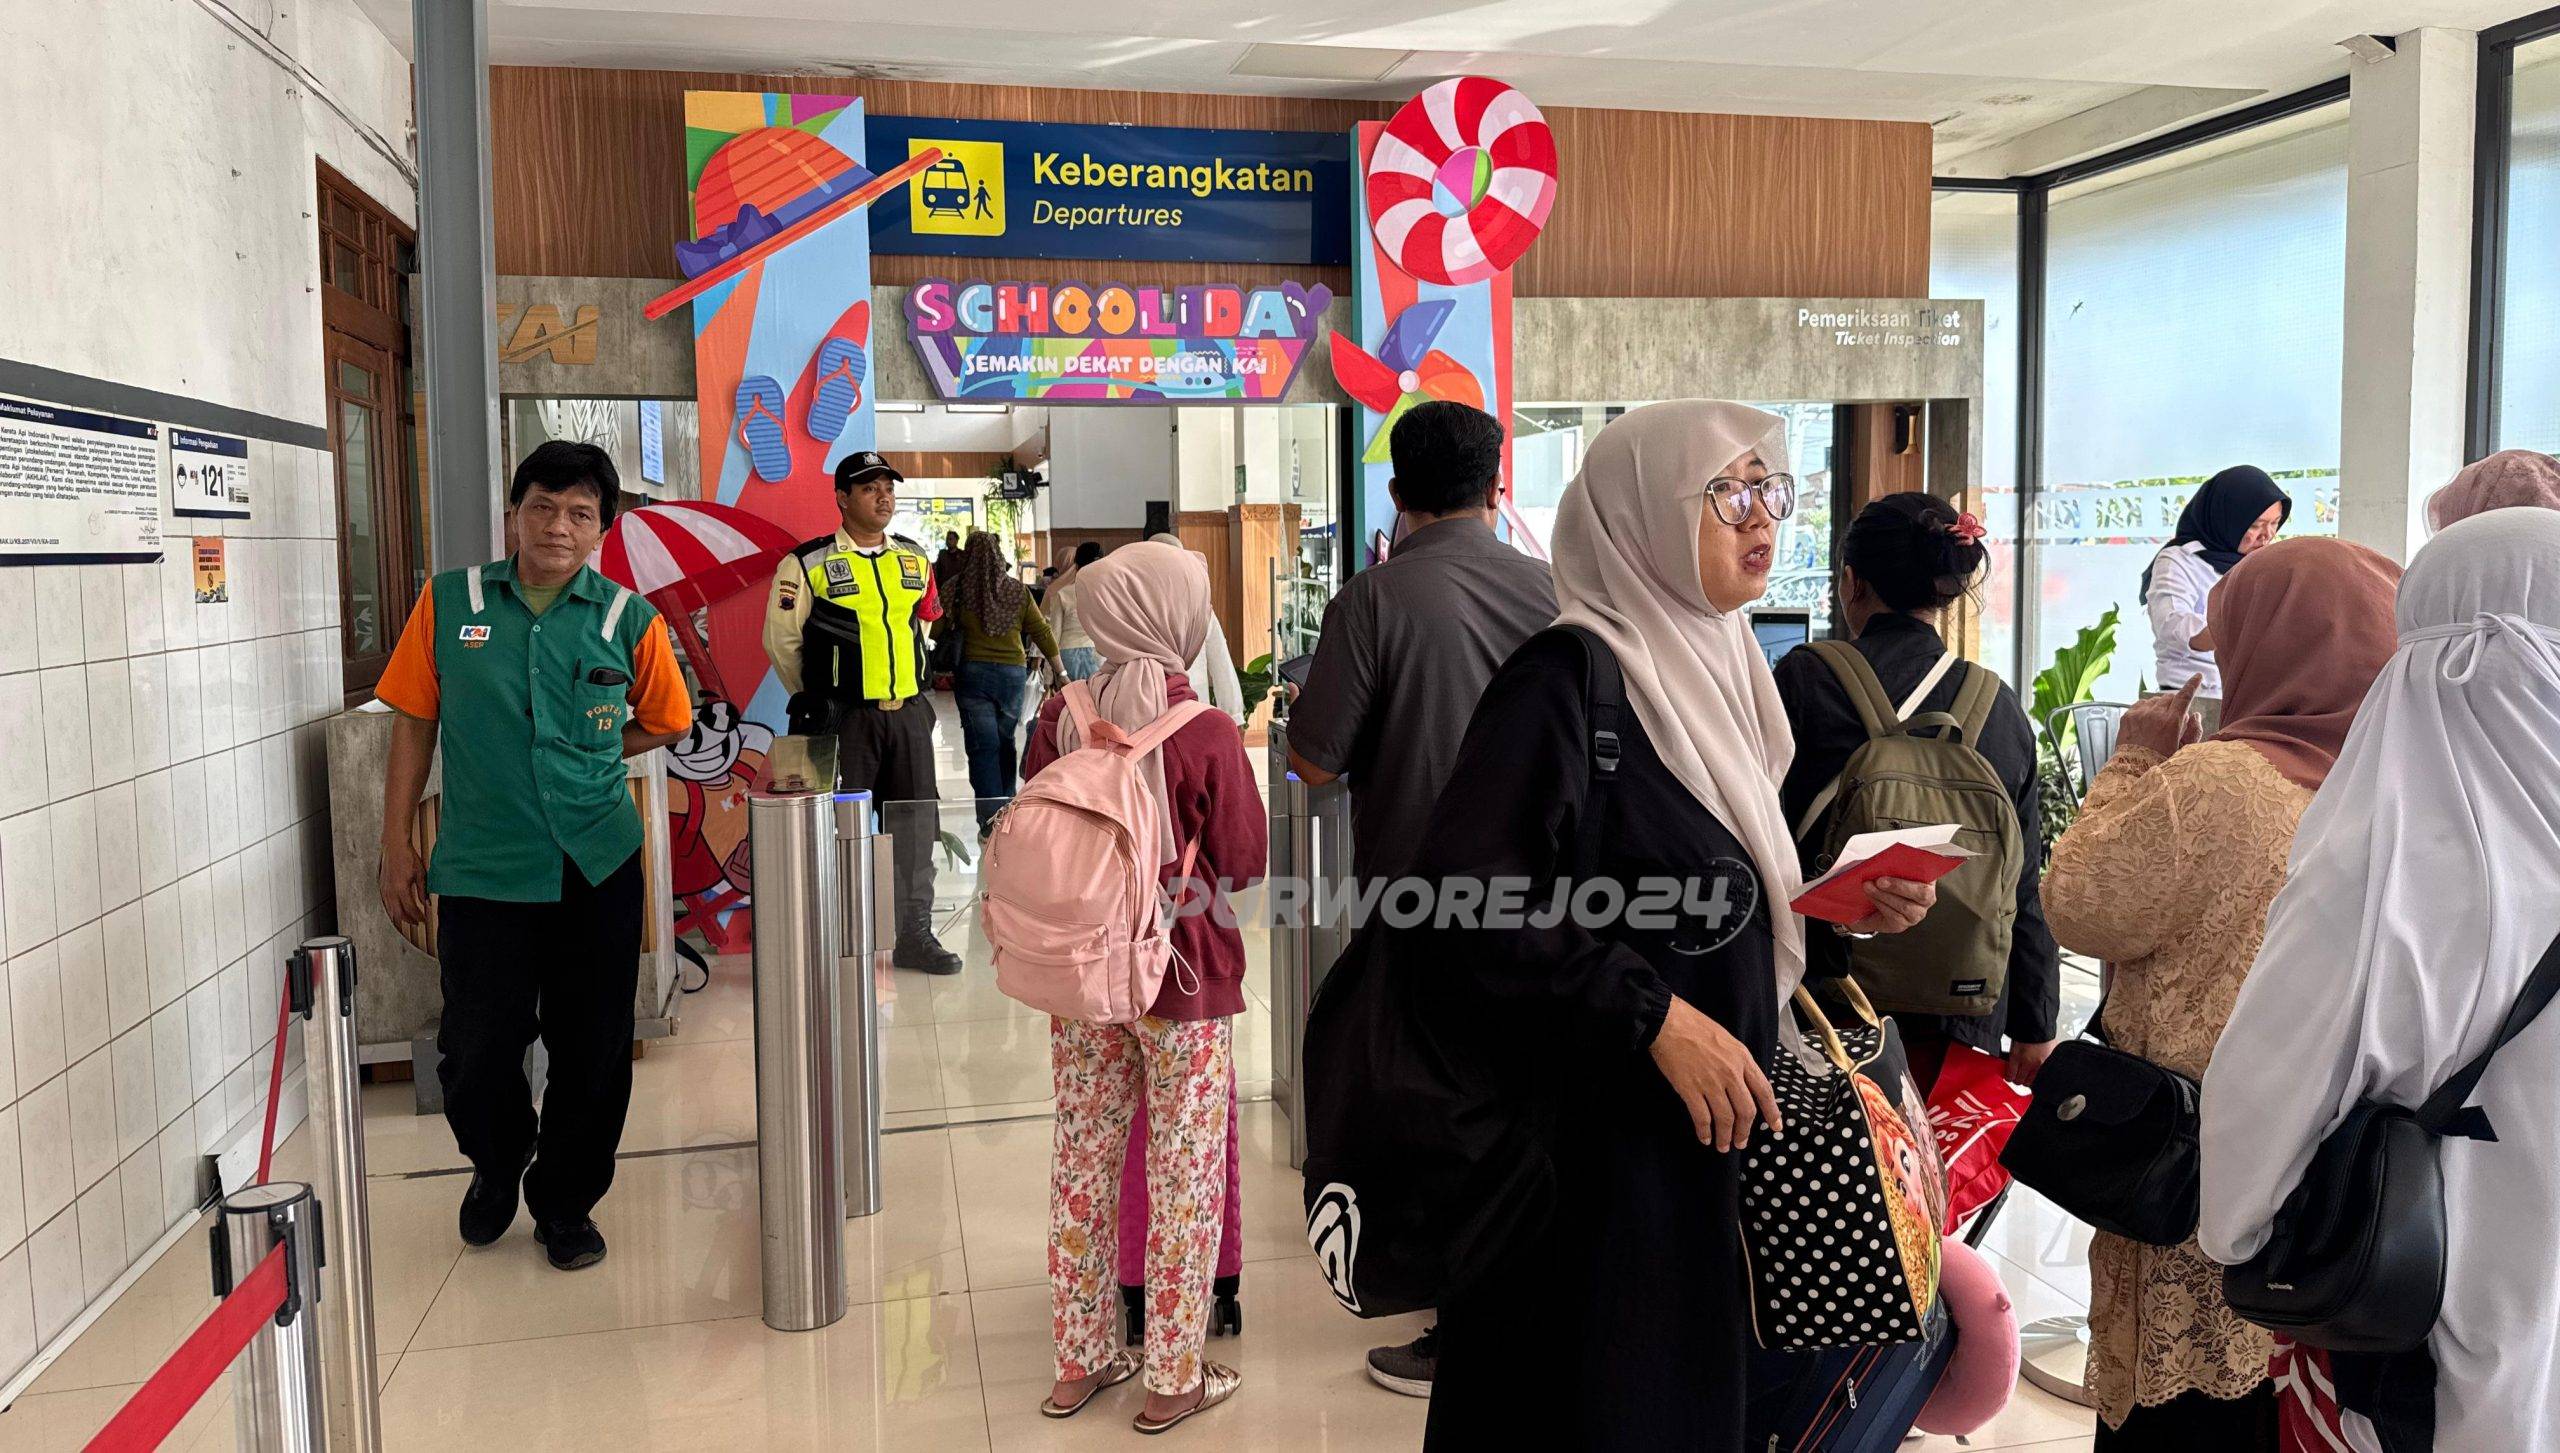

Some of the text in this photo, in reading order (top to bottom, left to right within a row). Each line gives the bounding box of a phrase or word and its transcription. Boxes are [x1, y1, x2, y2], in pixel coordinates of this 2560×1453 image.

[1033, 152, 1314, 198] Keberangkatan
[1032, 201, 1183, 231] Departures
[1798, 308, 1961, 328] Pemeriksaan Tiket
[497, 303, 600, 366] AI
[1835, 331, 1961, 348] Ticket Inspection
[964, 354, 1268, 376] SEMAKIN DEKAT DENGAN KAI
[201, 464, 224, 497] 121
[598, 718, 612, 731] 13
